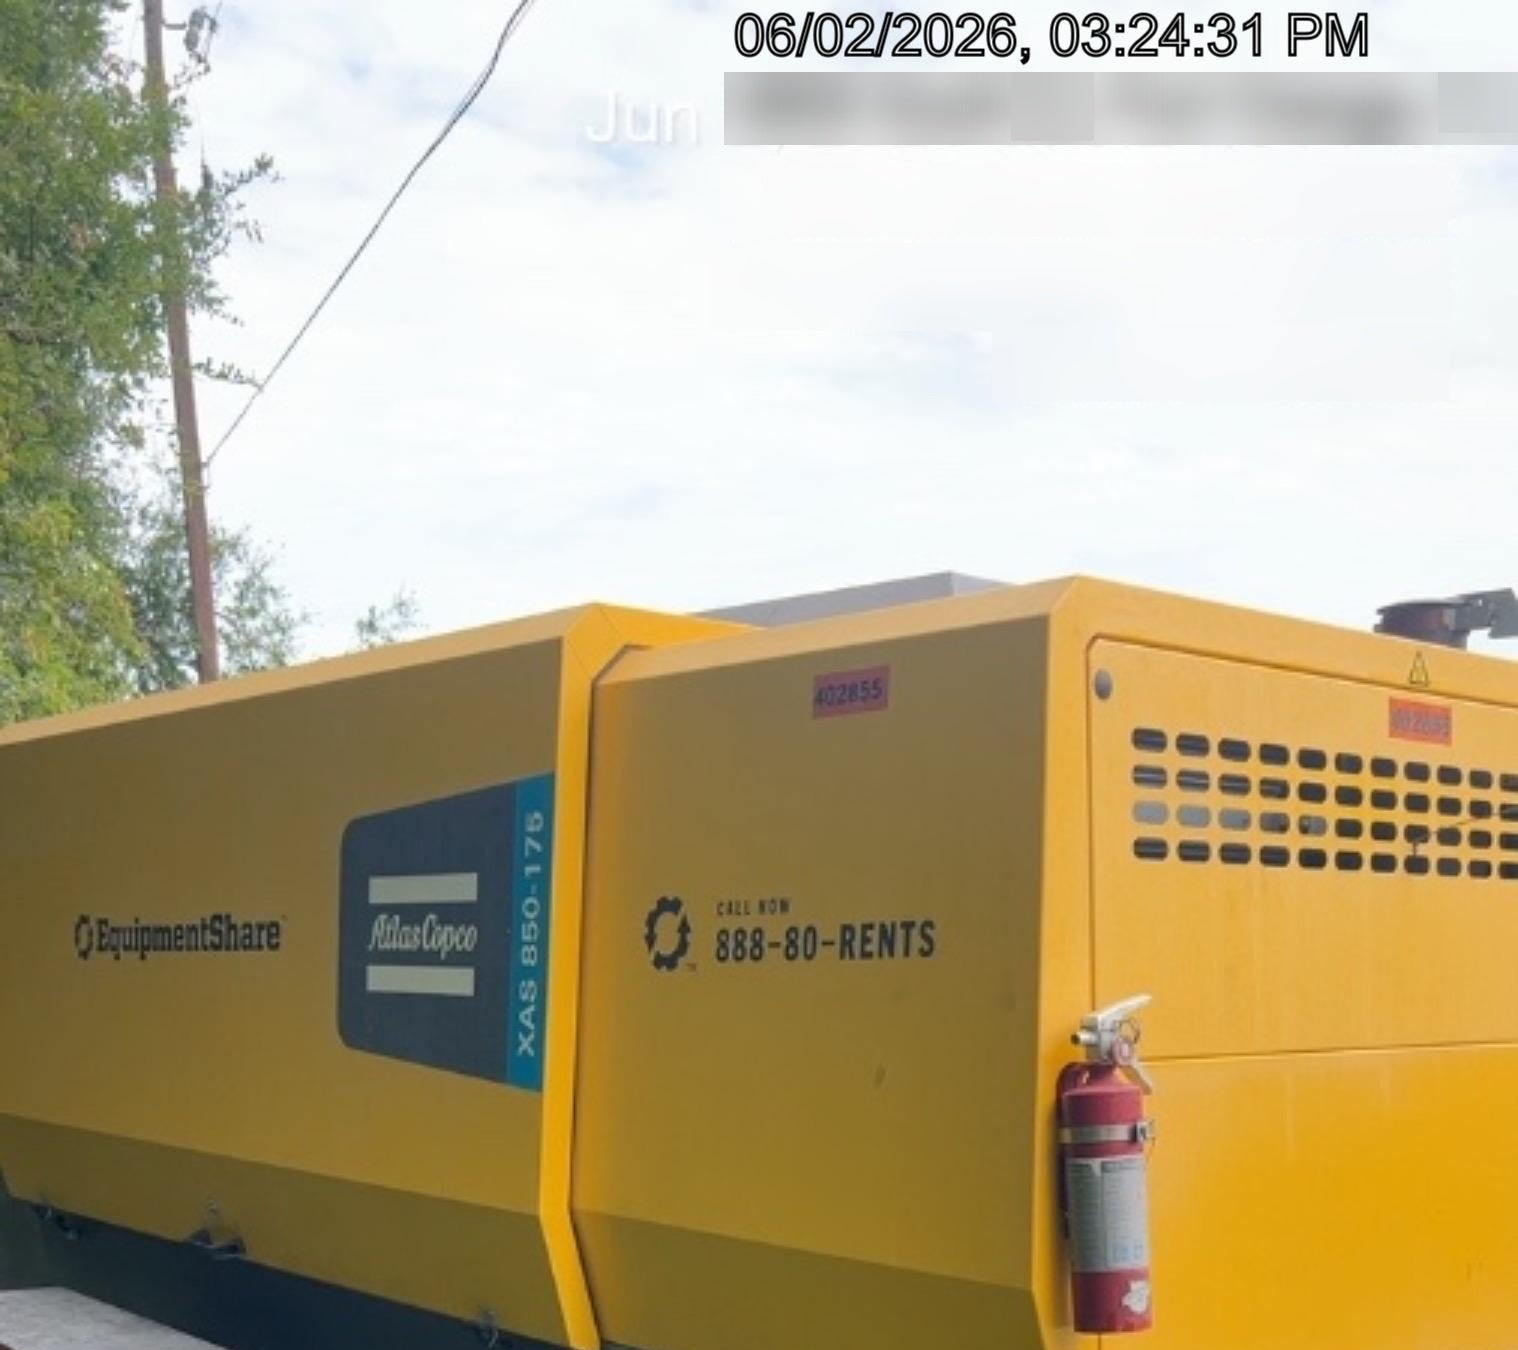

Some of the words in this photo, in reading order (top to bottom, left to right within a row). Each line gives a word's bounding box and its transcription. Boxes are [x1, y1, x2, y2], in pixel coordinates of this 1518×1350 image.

[522, 811, 544, 967] 850-175
[716, 900, 751, 916] CALL
[758, 899, 790, 914] NOW
[96, 914, 280, 960] EquipmentShare
[715, 920, 935, 962] 888-80-RENTS
[517, 979, 538, 1057] XAS
